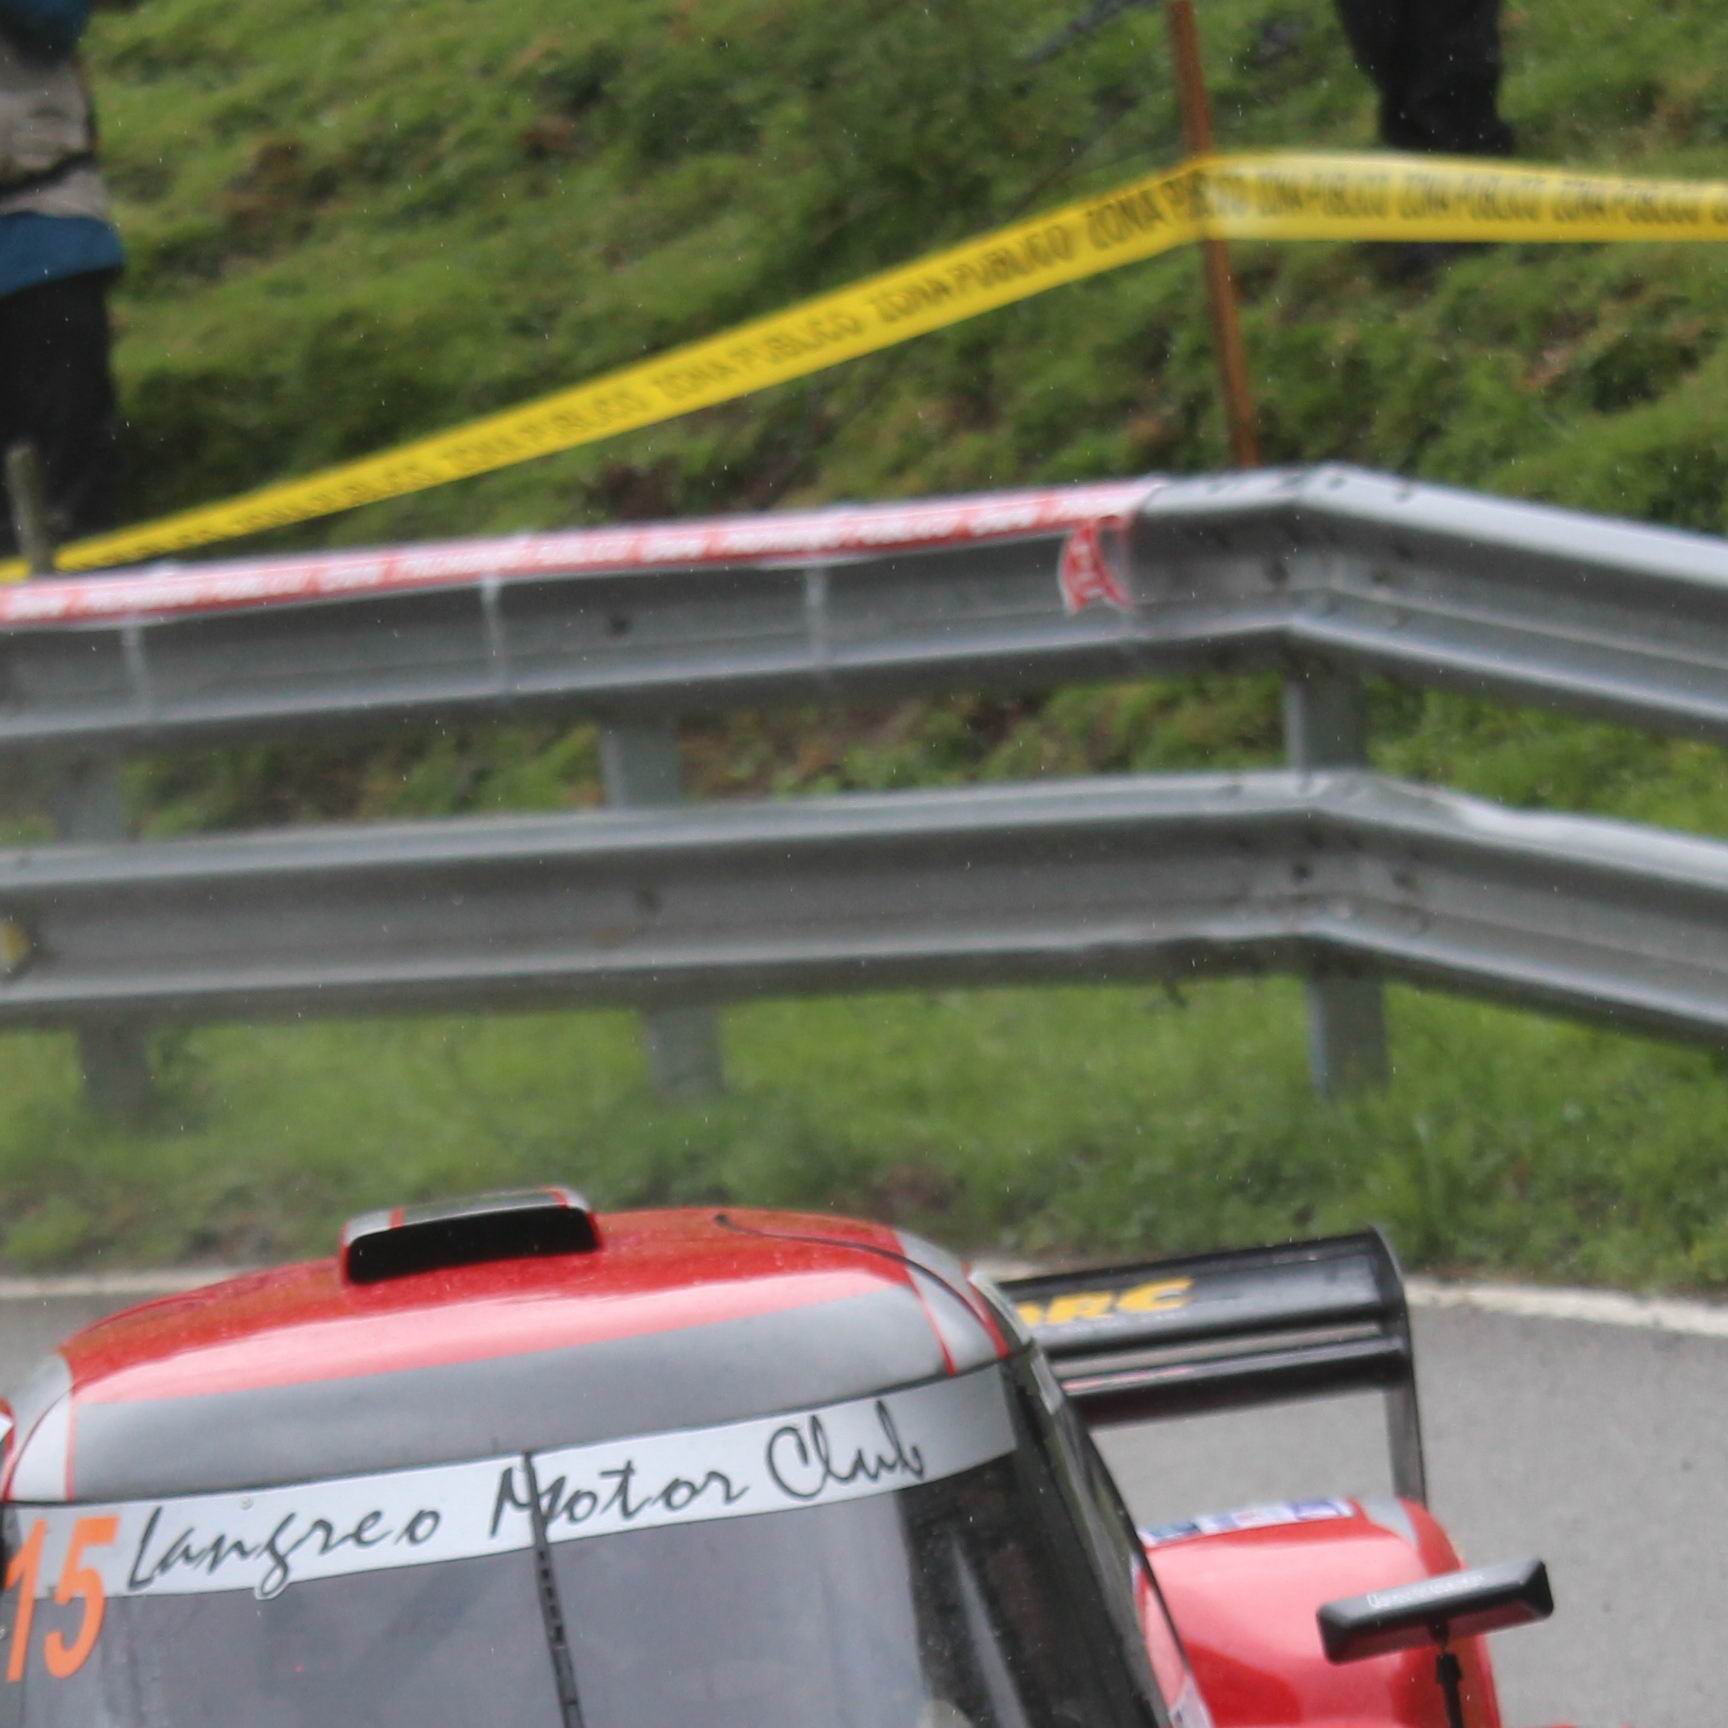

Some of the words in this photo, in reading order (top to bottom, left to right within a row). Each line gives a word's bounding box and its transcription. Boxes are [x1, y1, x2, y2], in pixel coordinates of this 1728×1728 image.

[124, 1506, 439, 1600] Langreo
[489, 1462, 748, 1543] Motor
[765, 1401, 927, 1500] Club
[4, 1514, 119, 1684] 15
